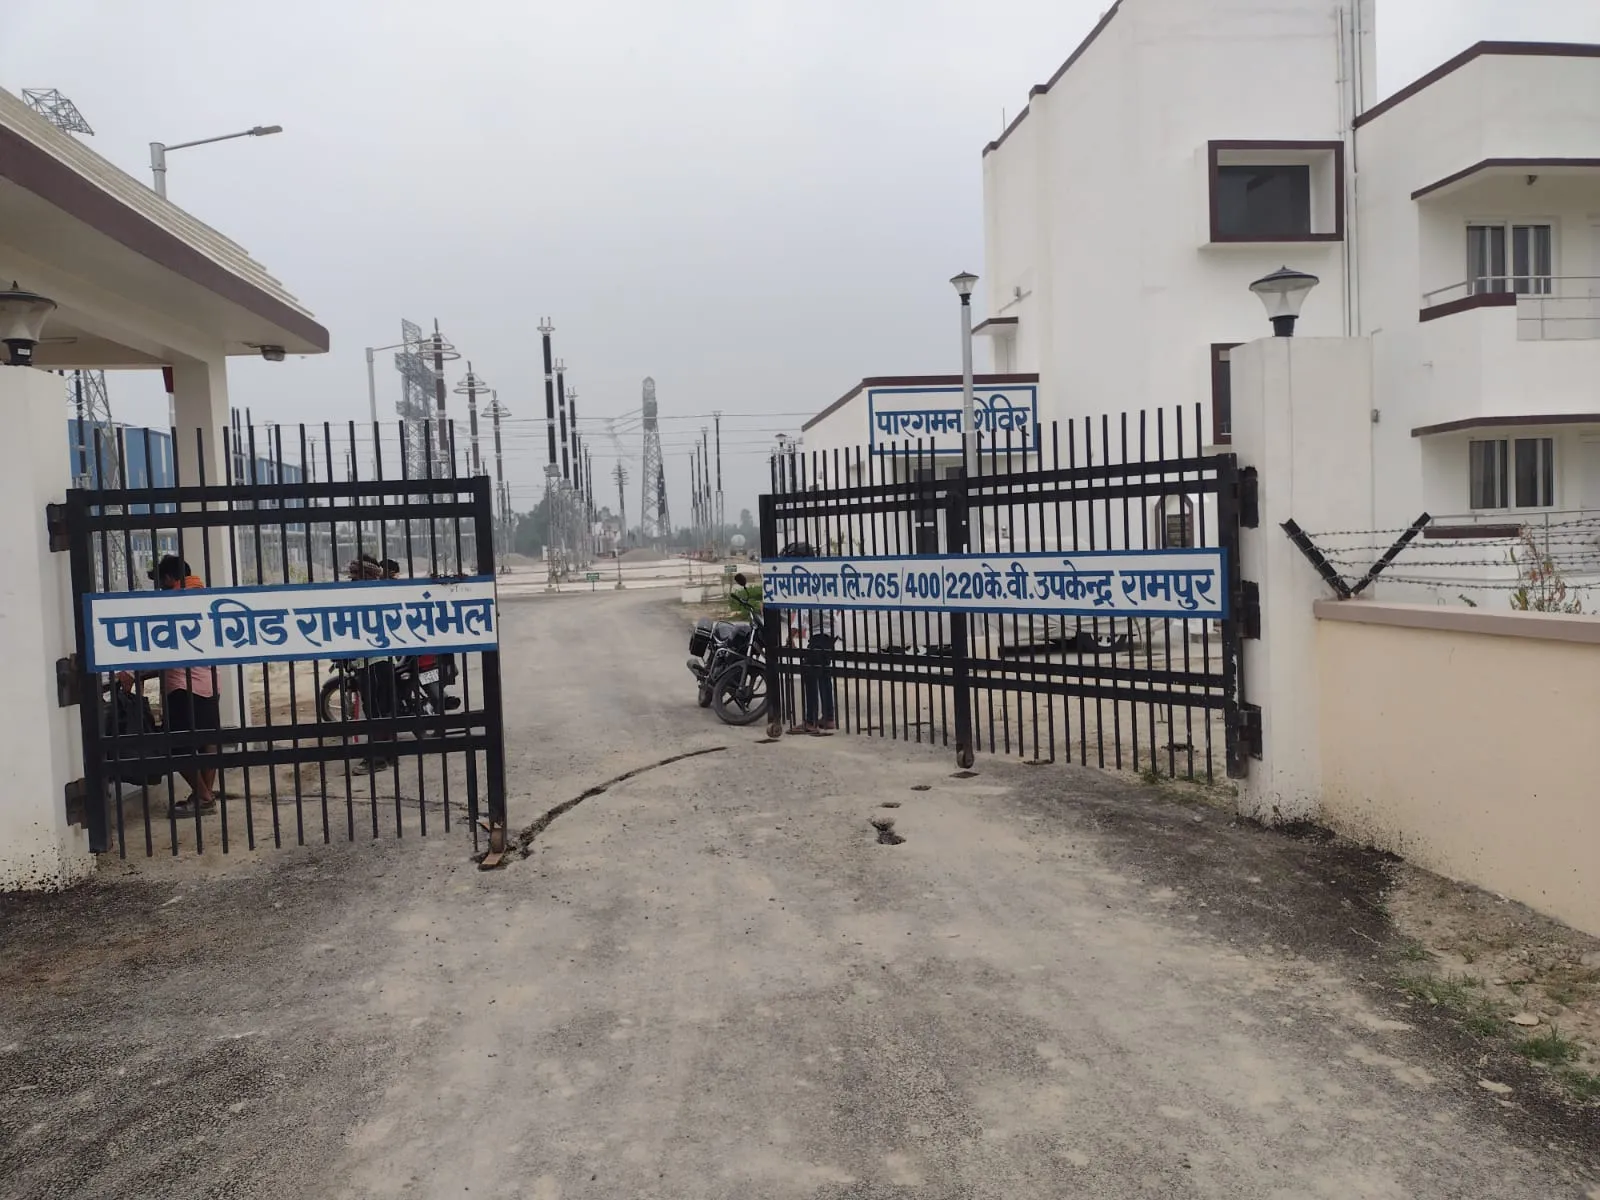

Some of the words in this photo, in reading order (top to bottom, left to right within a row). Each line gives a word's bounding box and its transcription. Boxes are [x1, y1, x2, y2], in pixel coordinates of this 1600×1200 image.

[875, 409, 963, 438] पारगमन
[762, 565, 838, 602] ट्रांसमिशन
[1118, 568, 1216, 610] रामपुर
[98, 612, 204, 653] पावर
[208, 598, 288, 648] ग्रिड
